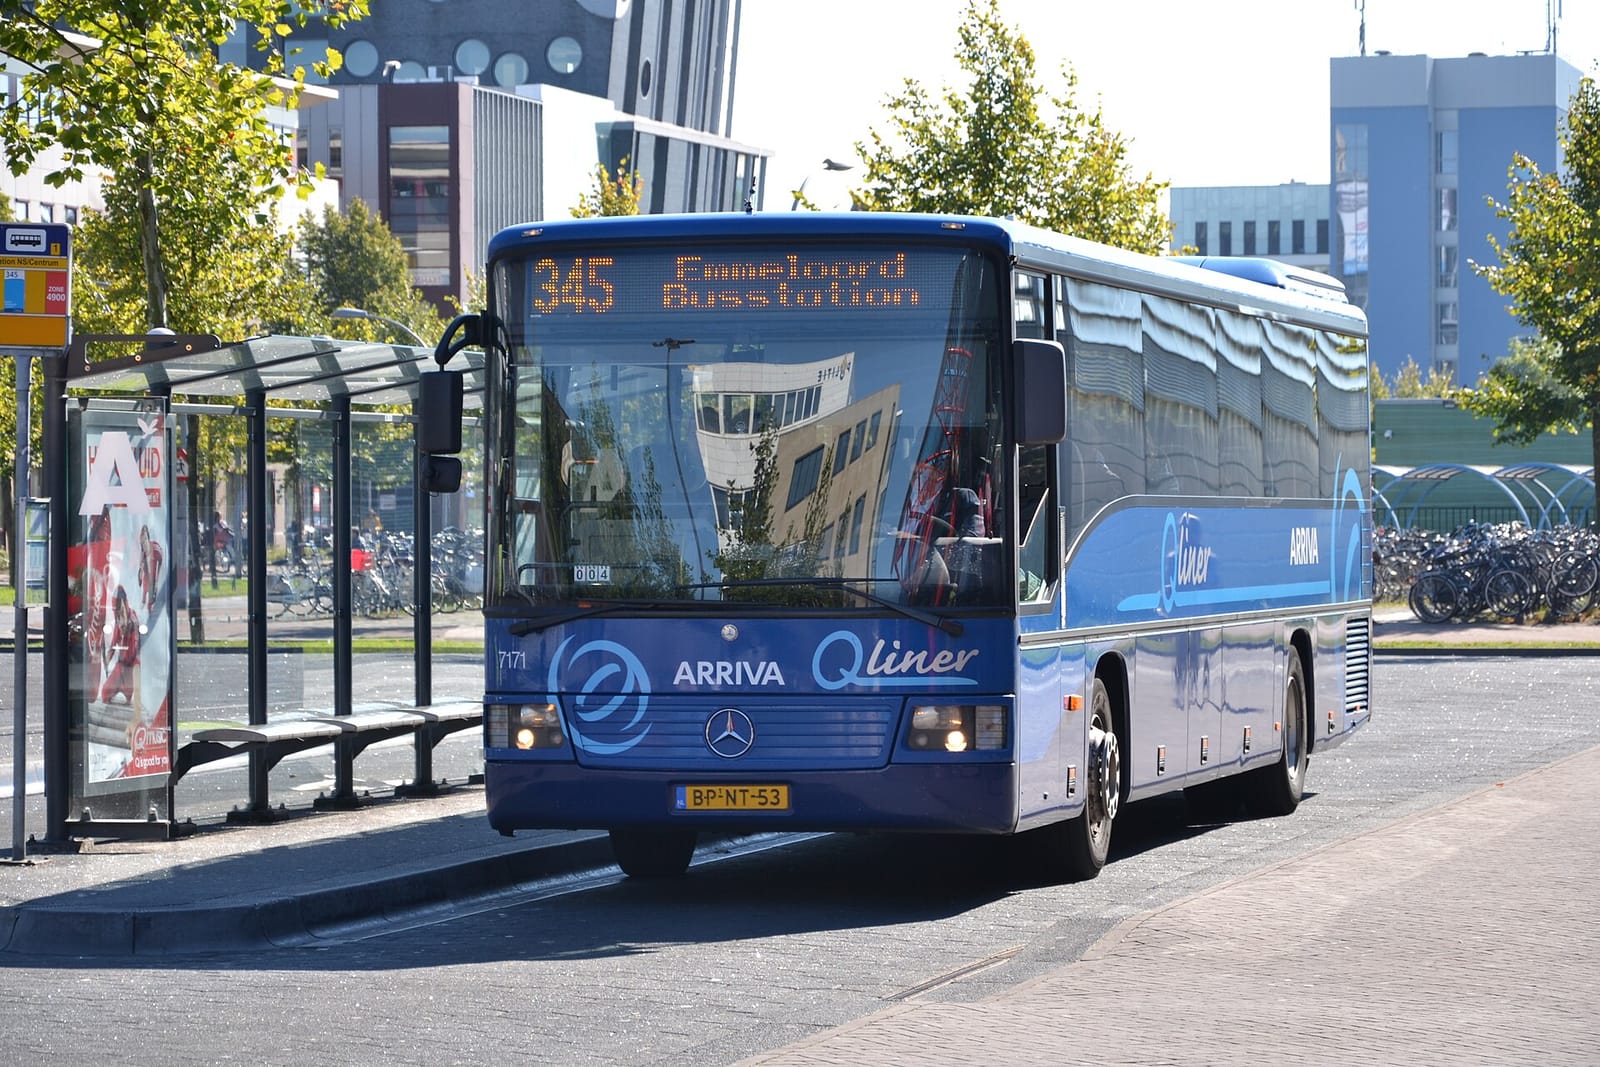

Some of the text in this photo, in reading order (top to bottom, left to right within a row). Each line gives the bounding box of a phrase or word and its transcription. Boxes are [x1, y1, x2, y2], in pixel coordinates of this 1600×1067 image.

[6, 270, 18, 278] 345
[675, 252, 905, 281] Emmeloord
[46, 293, 66, 302] 4900
[534, 256, 614, 314] 345
[662, 280, 920, 309] Busstation
[1290, 527, 1319, 566] ARRIVA
[575, 568, 609, 579] 004
[498, 651, 526, 669] 7171
[812, 630, 979, 690] Qliner
[673, 661, 785, 686] ARRIVA
[693, 788, 780, 807] BP-NT-53
